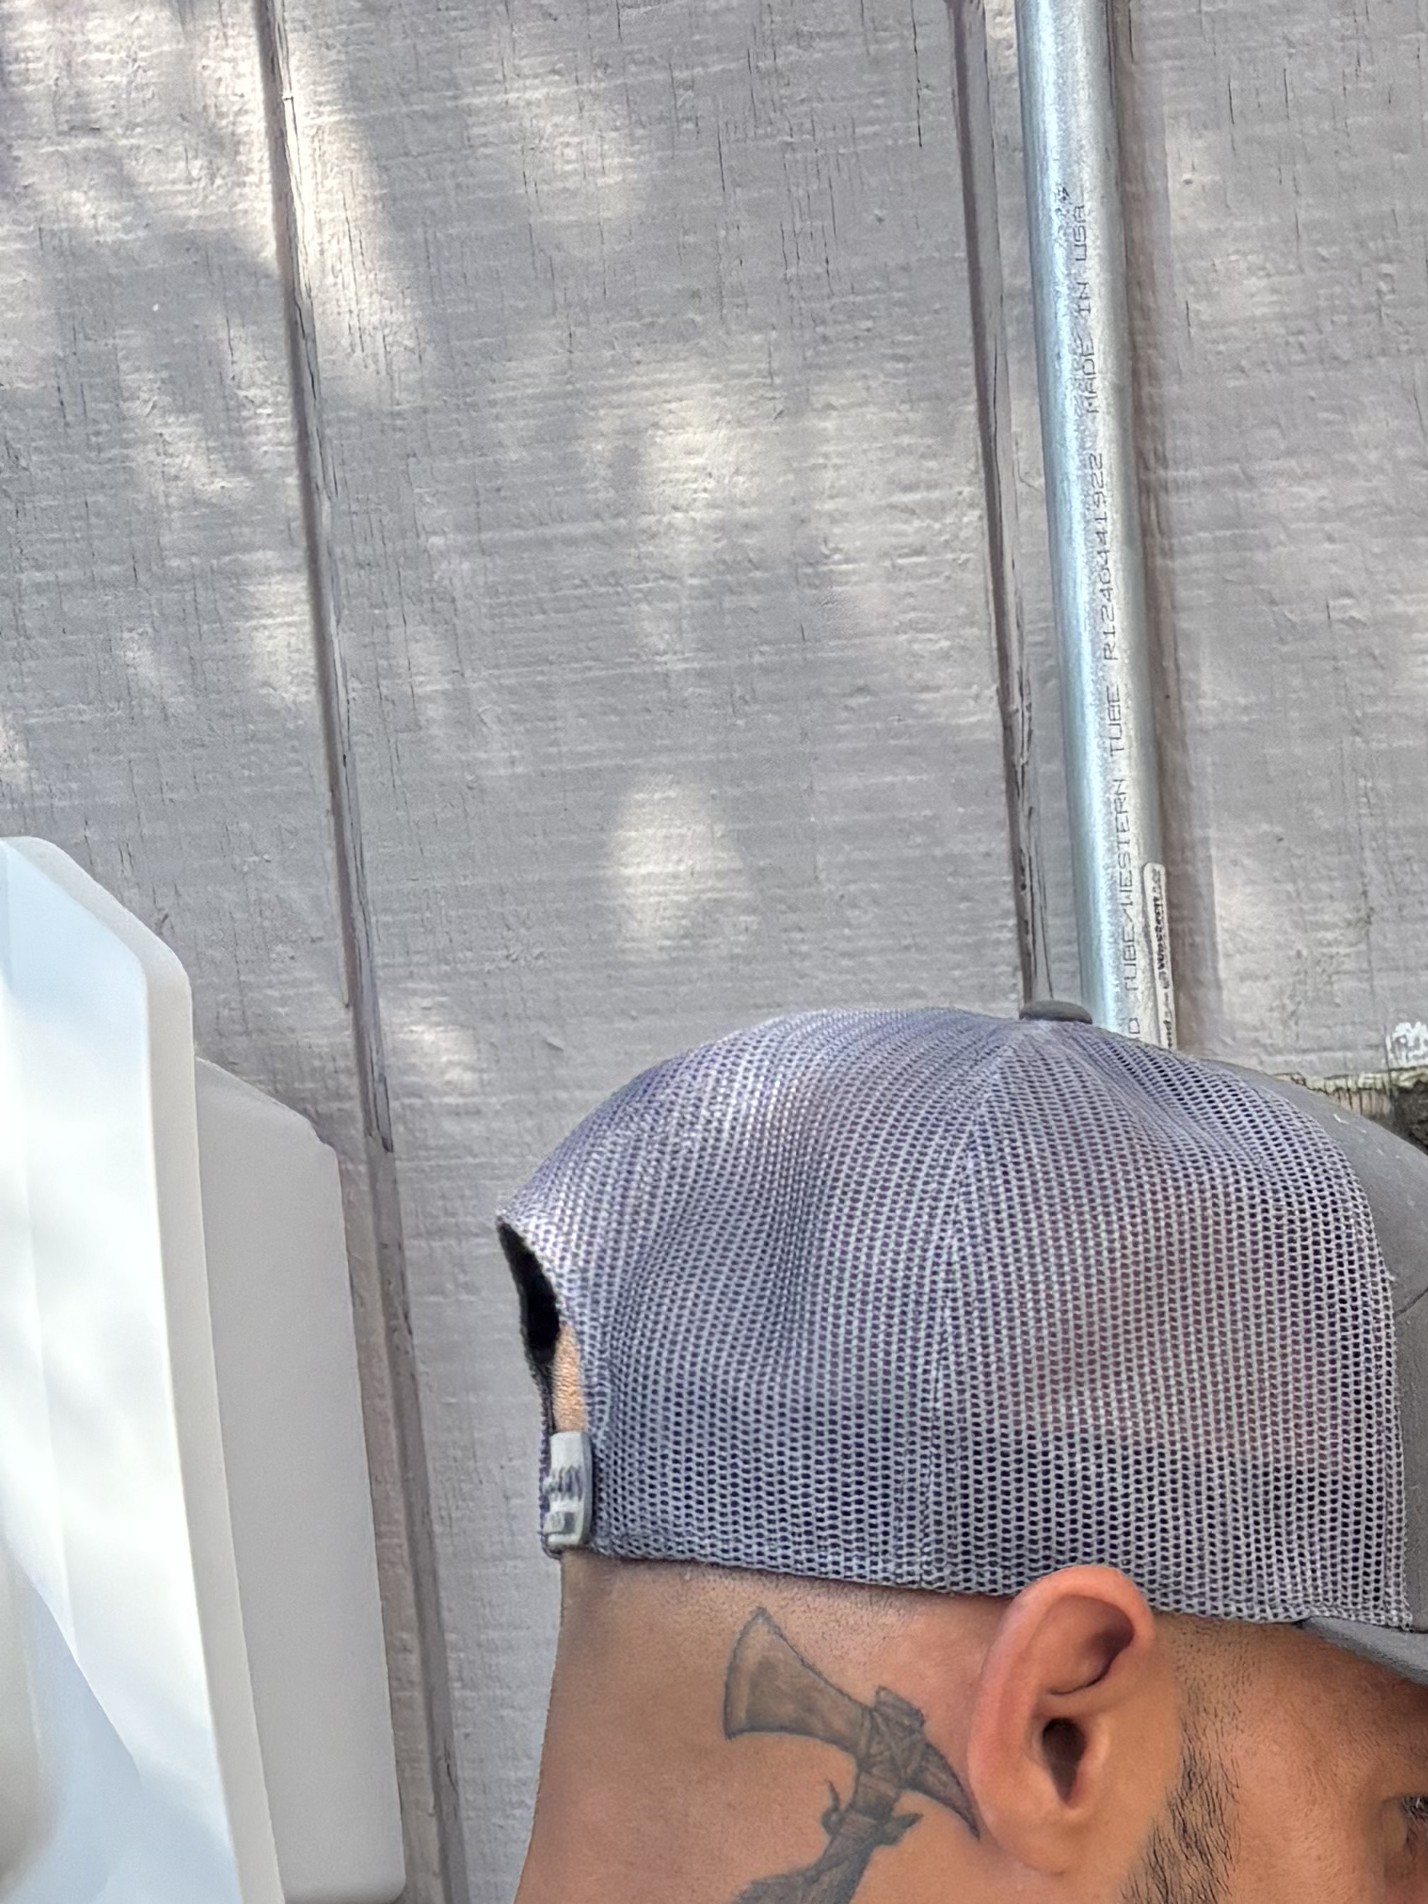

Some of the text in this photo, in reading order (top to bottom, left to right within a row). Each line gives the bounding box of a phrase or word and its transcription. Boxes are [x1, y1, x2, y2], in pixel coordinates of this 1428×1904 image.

[1072, 204, 1088, 262] USA
[1076, 281, 1092, 314] IN
[1079, 330, 1099, 413] MADE
[1106, 683, 1125, 757] TUBE
